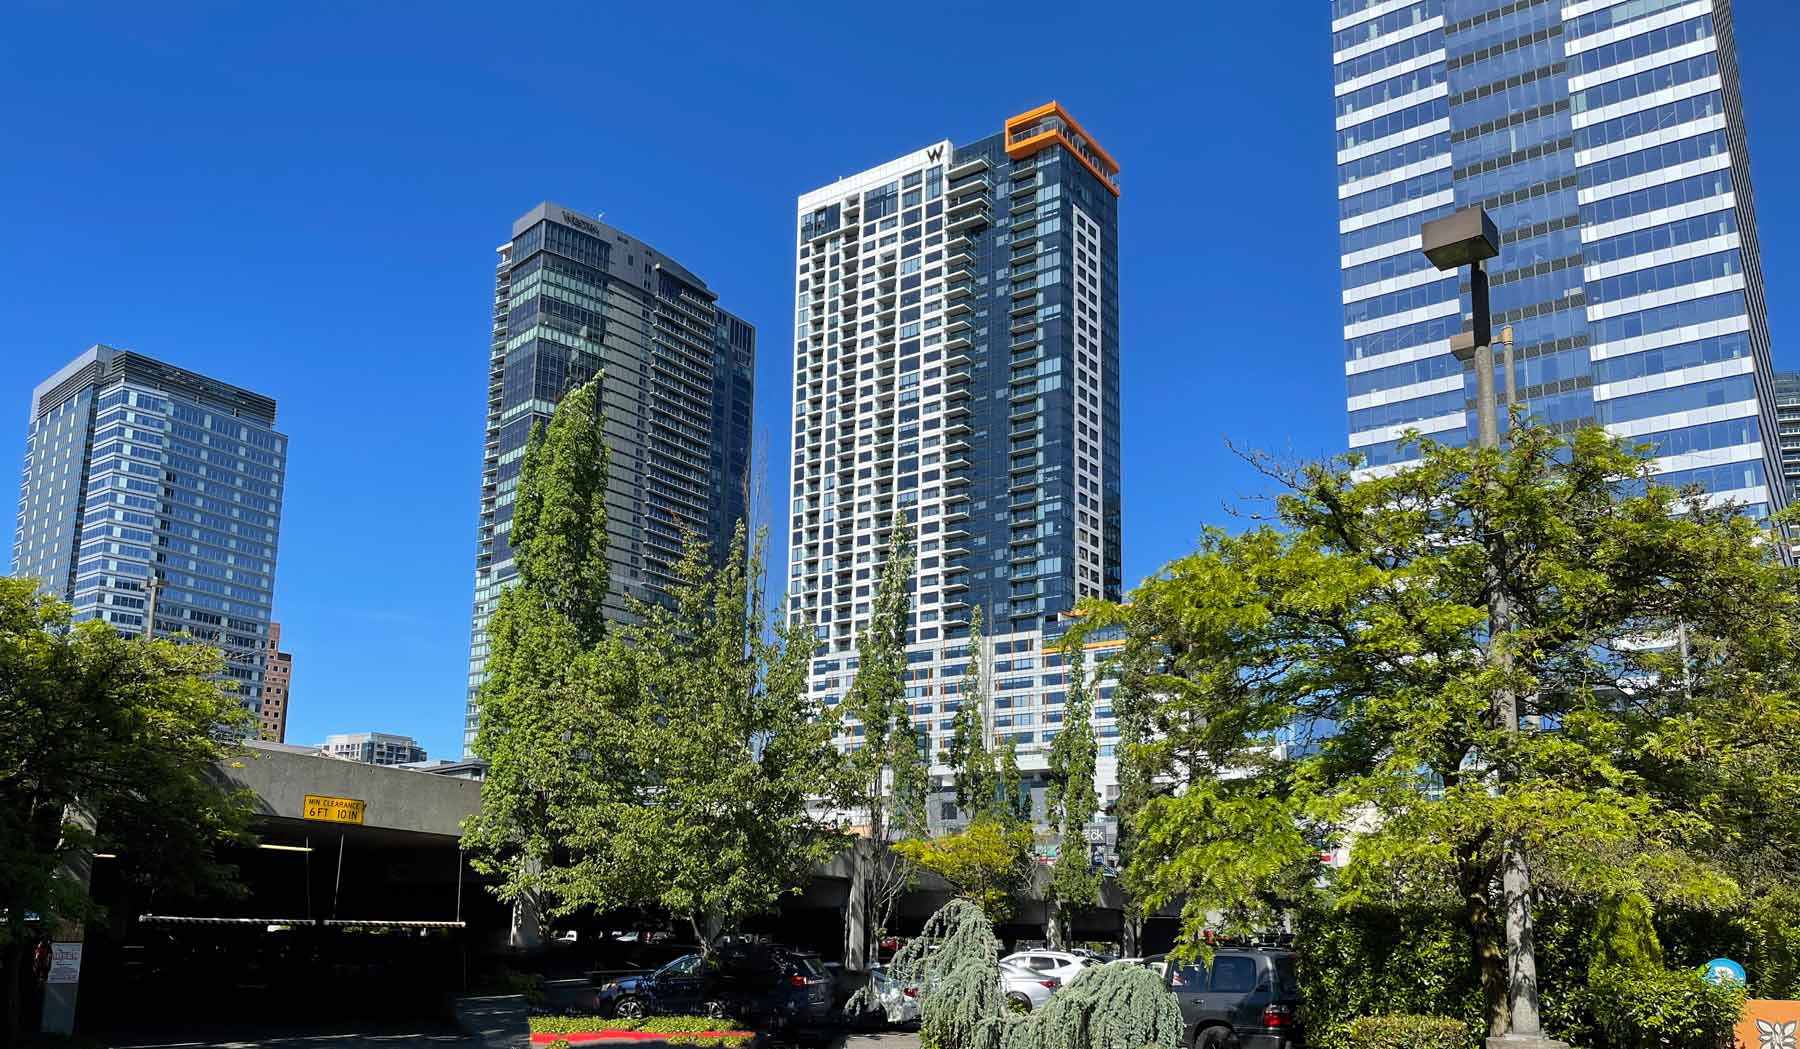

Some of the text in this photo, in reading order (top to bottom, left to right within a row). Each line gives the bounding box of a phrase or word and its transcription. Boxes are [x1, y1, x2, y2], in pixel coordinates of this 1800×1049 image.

[926, 144, 944, 165] W
[309, 799, 360, 809] MIN CLEARANCE
